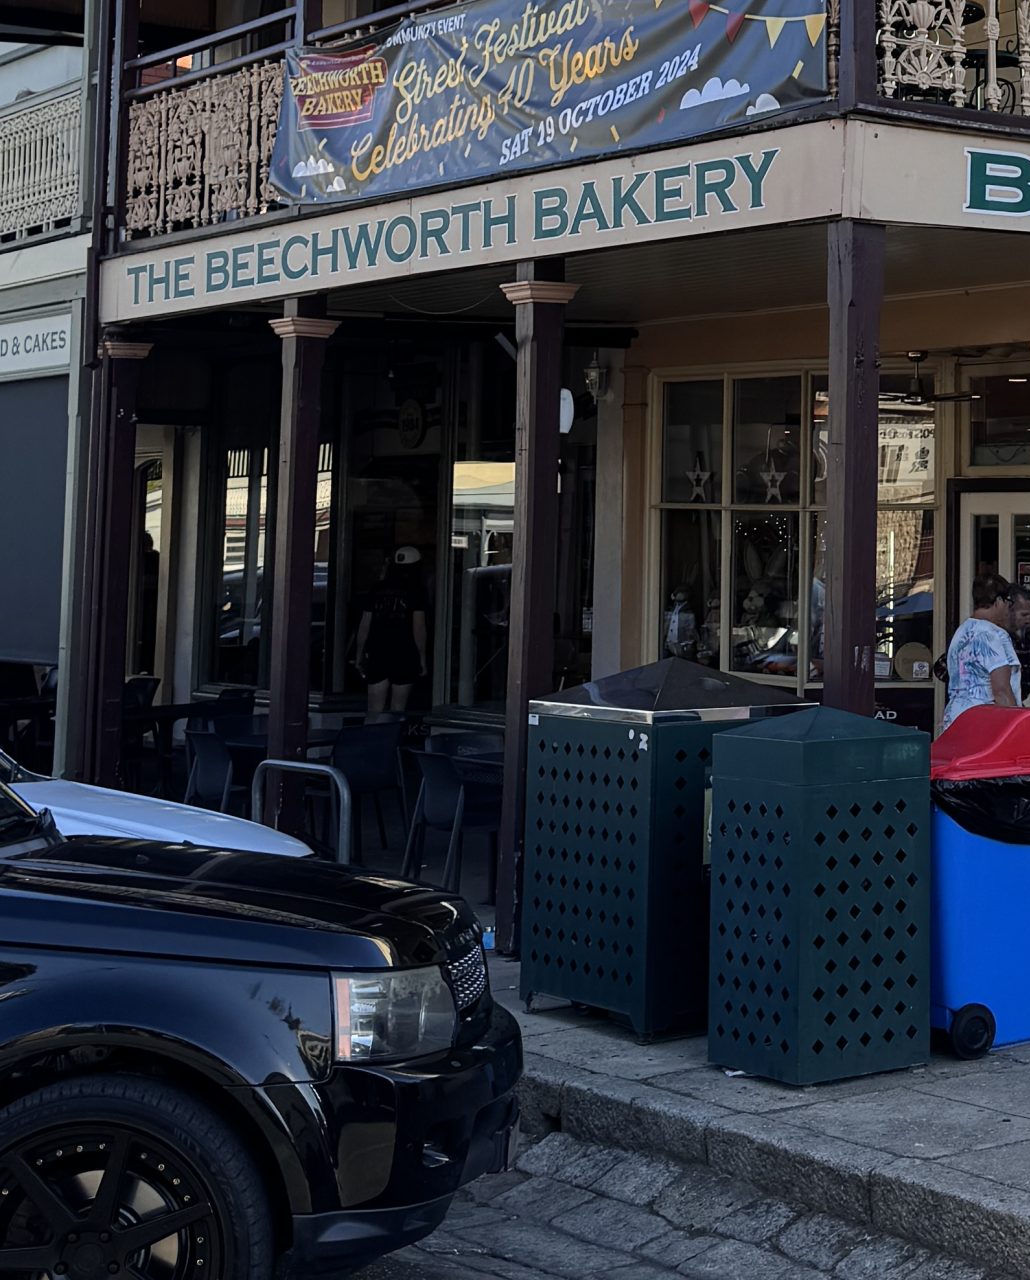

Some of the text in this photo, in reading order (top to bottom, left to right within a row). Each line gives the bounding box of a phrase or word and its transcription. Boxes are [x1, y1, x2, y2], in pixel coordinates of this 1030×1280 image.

[438, 14, 466, 34] EVENT
[301, 89, 364, 116] BAKERY
[351, 25, 639, 181] Celebrating 40 Years
[393, 37, 468, 124] Street
[500, 43, 703, 165] SAT 19 OCTOBER 2024
[126, 148, 780, 306] THE BEECHWORTH BAKERY
[11, 336, 20, 356] &
[23, 330, 67, 354] CAKES
